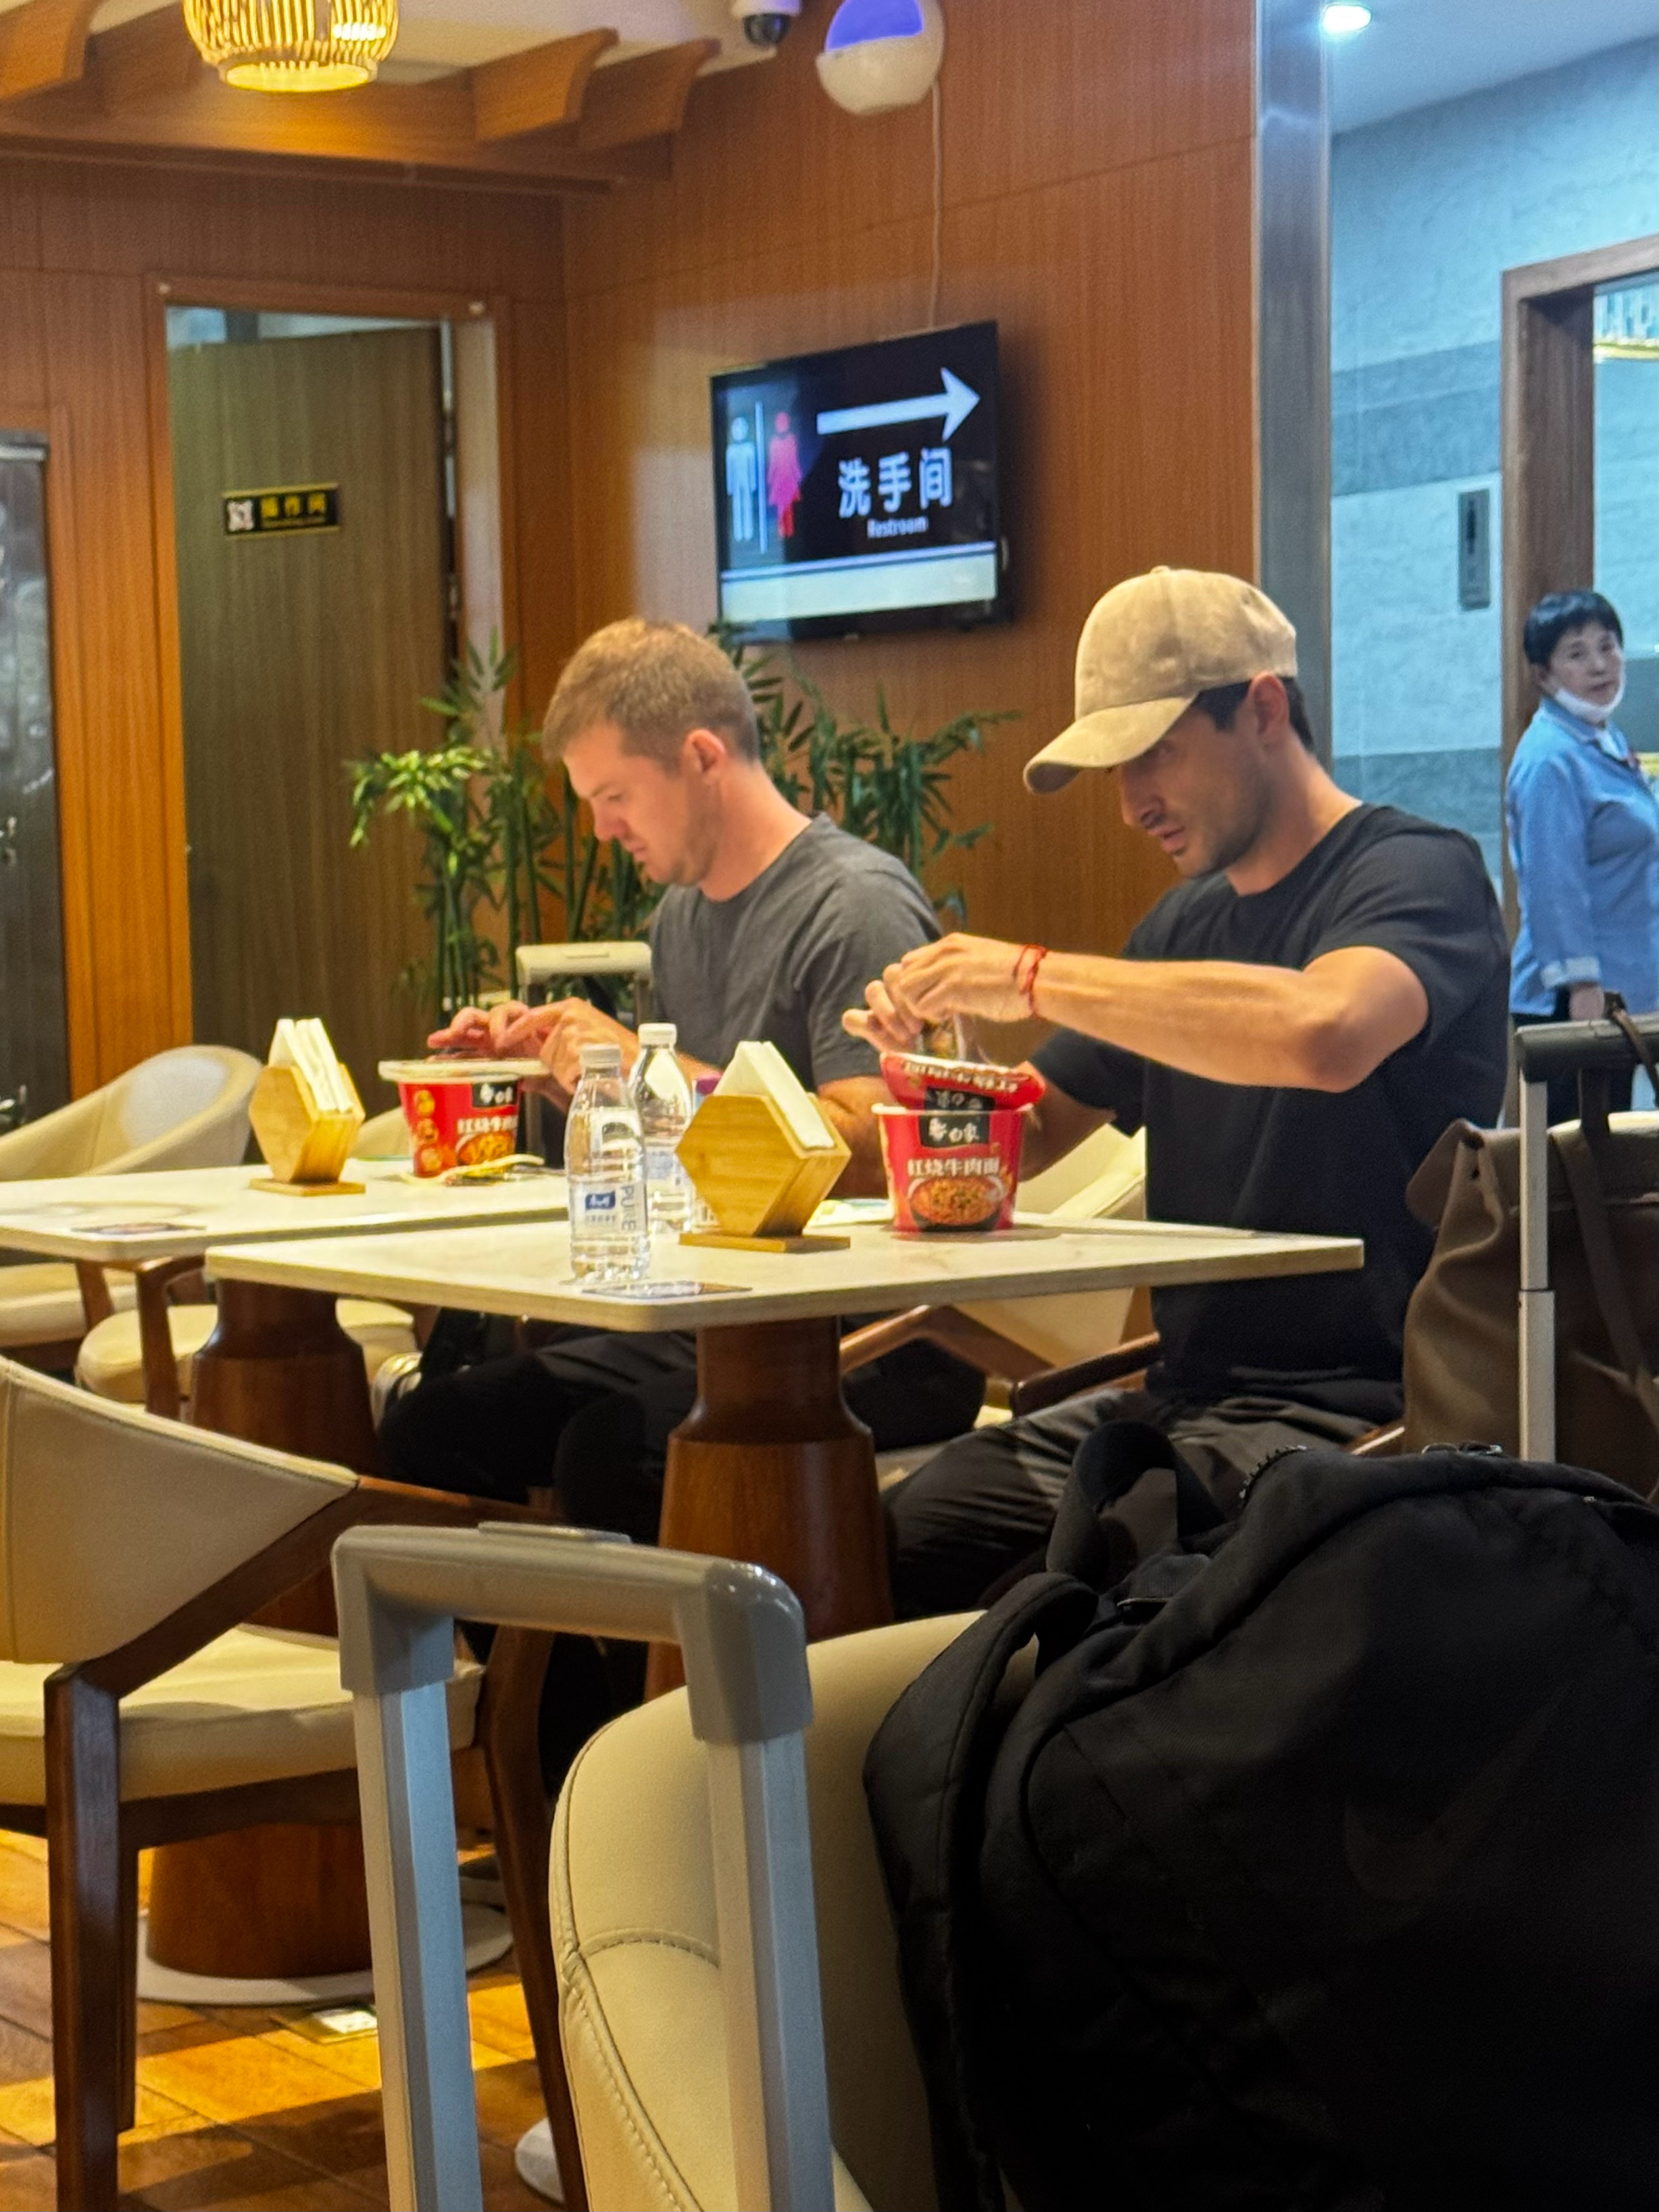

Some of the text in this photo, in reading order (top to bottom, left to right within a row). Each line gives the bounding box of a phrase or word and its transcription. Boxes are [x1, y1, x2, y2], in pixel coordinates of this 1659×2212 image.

[838, 447, 953, 518] 洗手间
[867, 516, 929, 538] Restroom
[907, 1158, 1000, 1177] 红烧牛肉面
